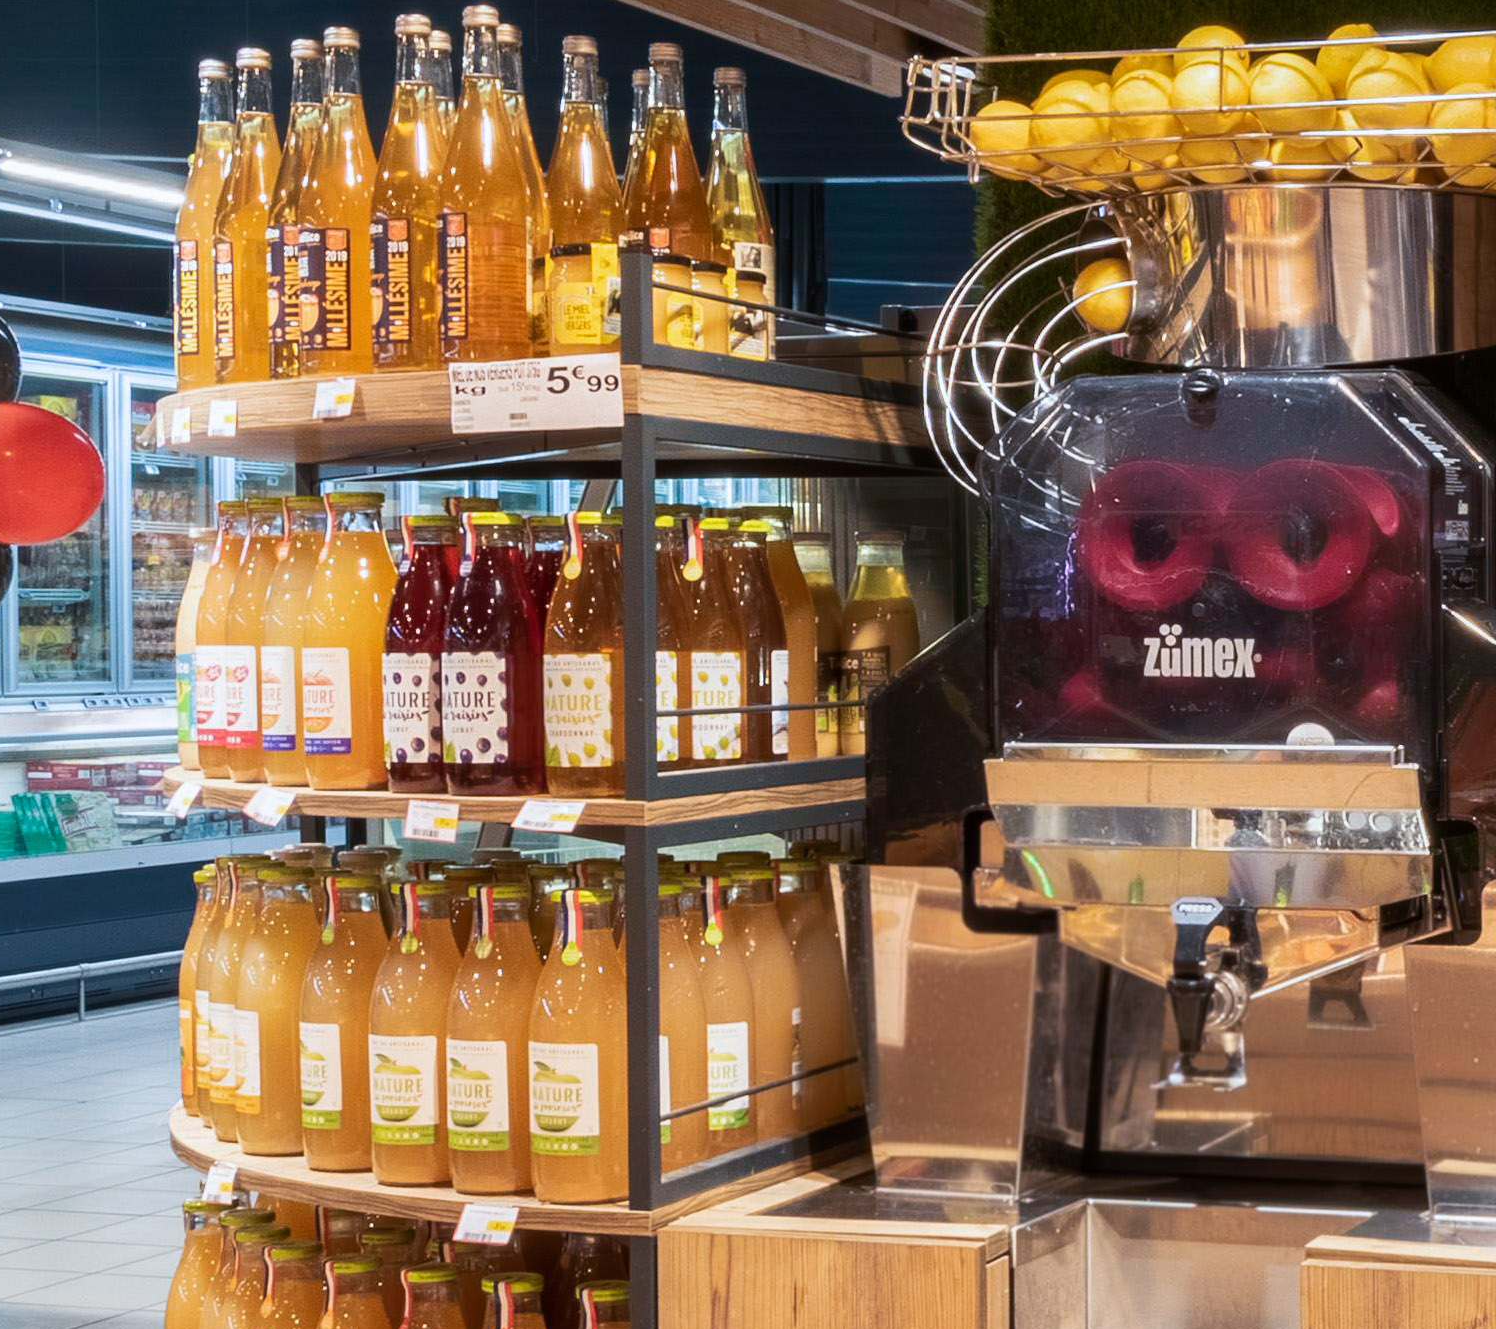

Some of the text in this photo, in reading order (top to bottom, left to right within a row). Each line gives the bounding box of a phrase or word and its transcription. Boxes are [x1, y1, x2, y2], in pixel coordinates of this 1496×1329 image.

[387, 241, 409, 253] 2019
[445, 235, 466, 248] 2019
[282, 245, 299, 257] 201
[324, 250, 348, 262] 2019
[455, 385, 486, 396] kg
